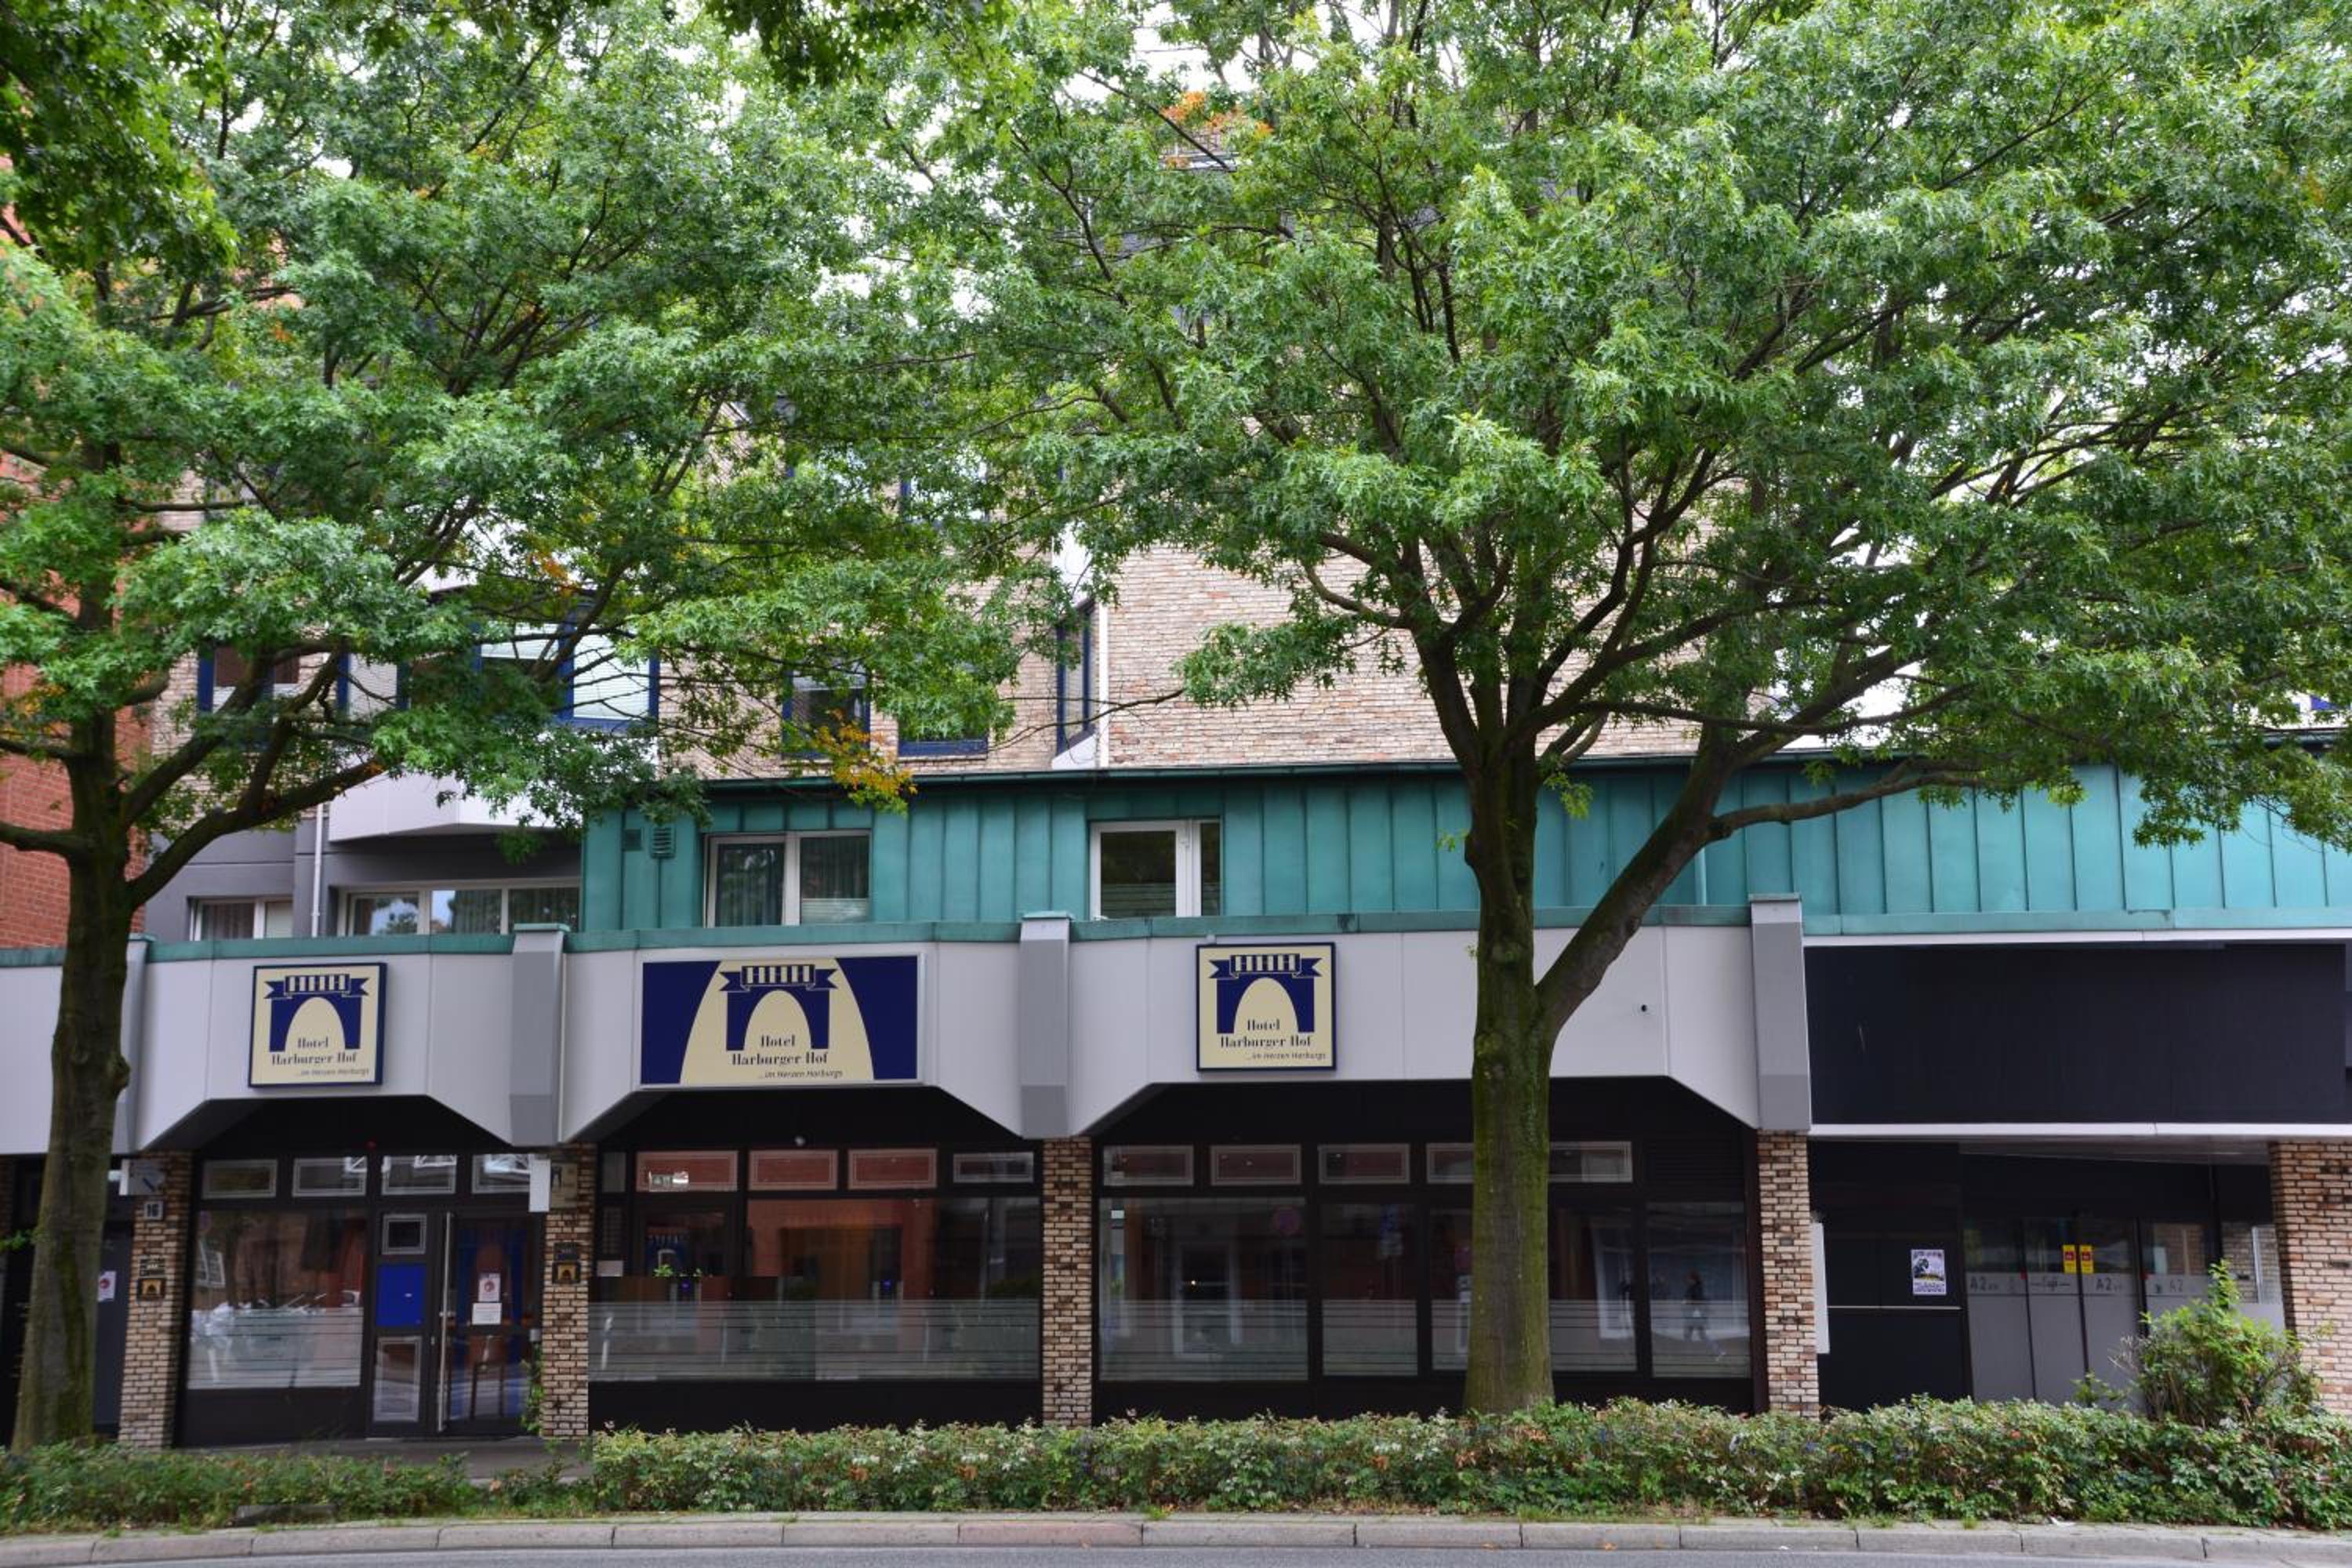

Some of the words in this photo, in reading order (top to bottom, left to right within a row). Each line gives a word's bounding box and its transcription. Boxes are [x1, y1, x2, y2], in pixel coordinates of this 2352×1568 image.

[1247, 1018, 1279, 1031] Hotel
[297, 1036, 328, 1048] Hotel
[760, 1034, 795, 1047] Hotel
[1221, 1036, 1286, 1048] Harburger
[1290, 1035, 1311, 1047] Hof
[272, 1053, 333, 1066] Harburger
[337, 1052, 357, 1064] Hof
[732, 1053, 801, 1066] Harburger
[806, 1051, 829, 1064] Hof
[147, 1203, 159, 1217] 16
